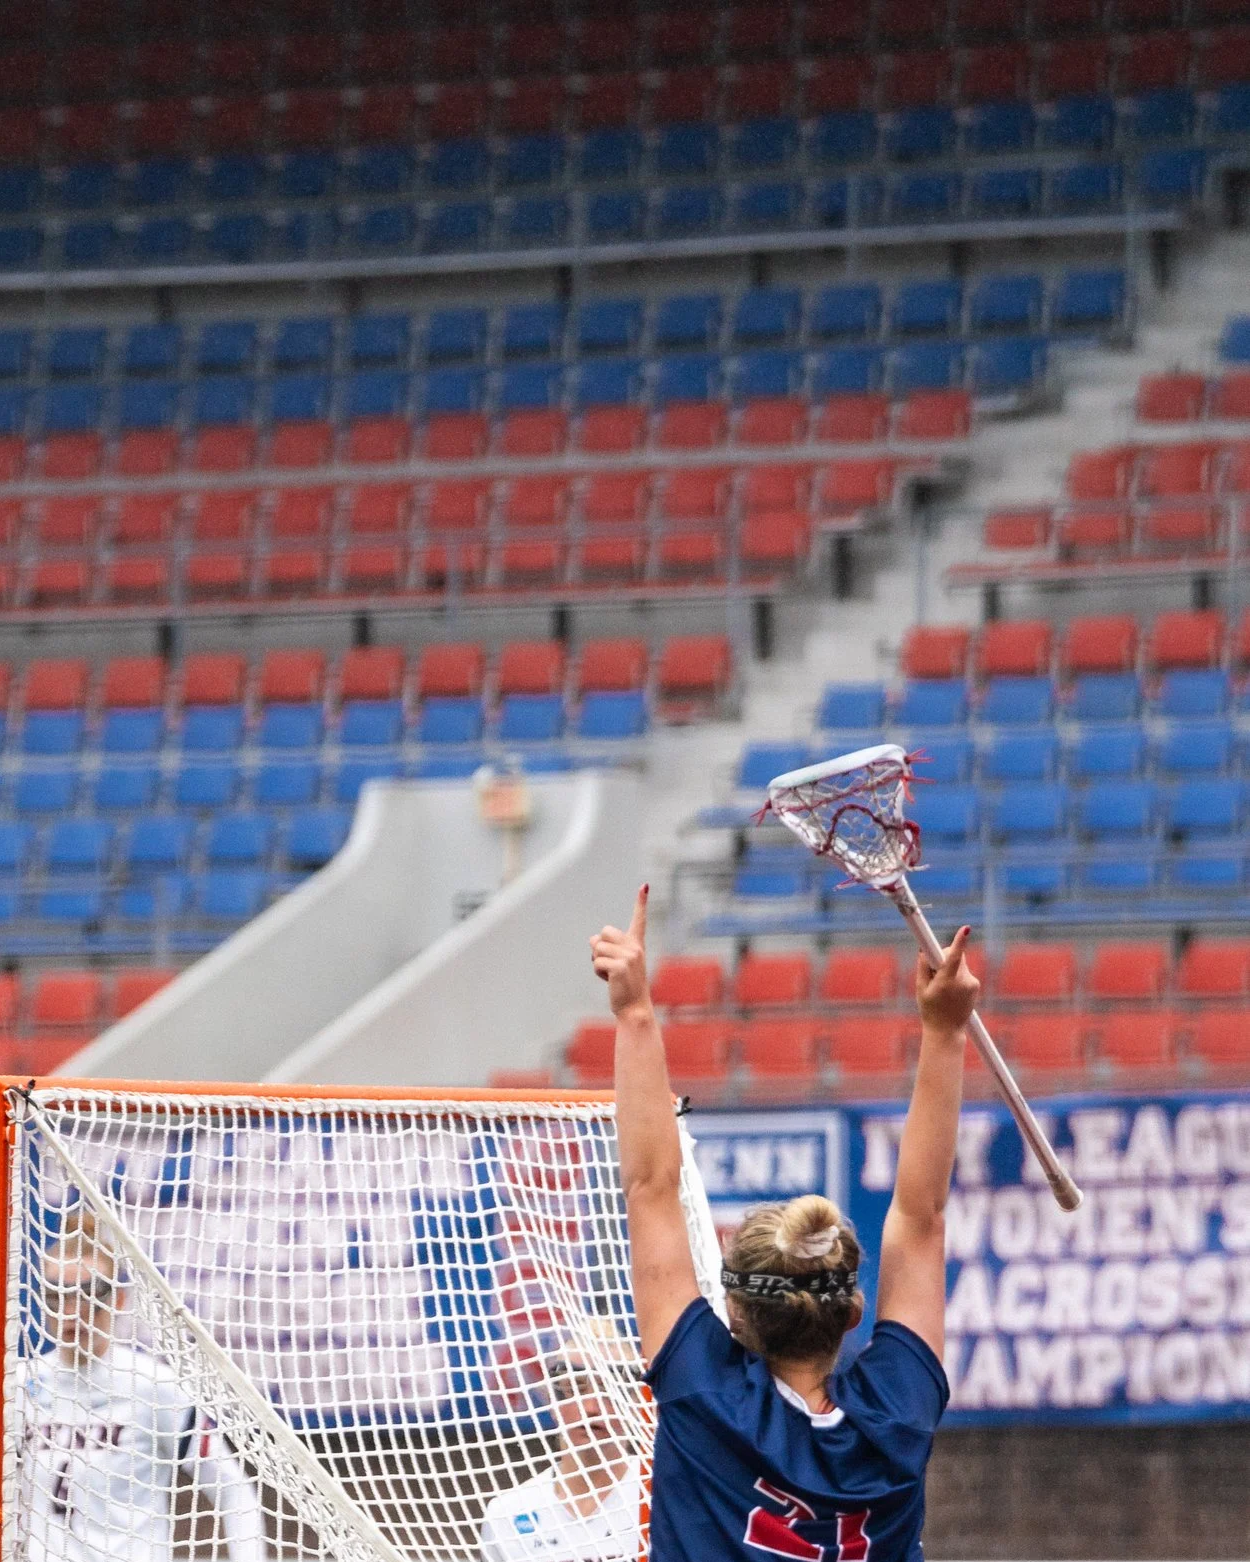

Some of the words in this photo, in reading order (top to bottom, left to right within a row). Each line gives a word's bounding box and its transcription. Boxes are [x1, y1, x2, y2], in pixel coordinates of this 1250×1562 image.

[696, 1137, 816, 1192] ENN
[861, 1112, 996, 1190] IY
[748, 1273, 795, 1288] STX
